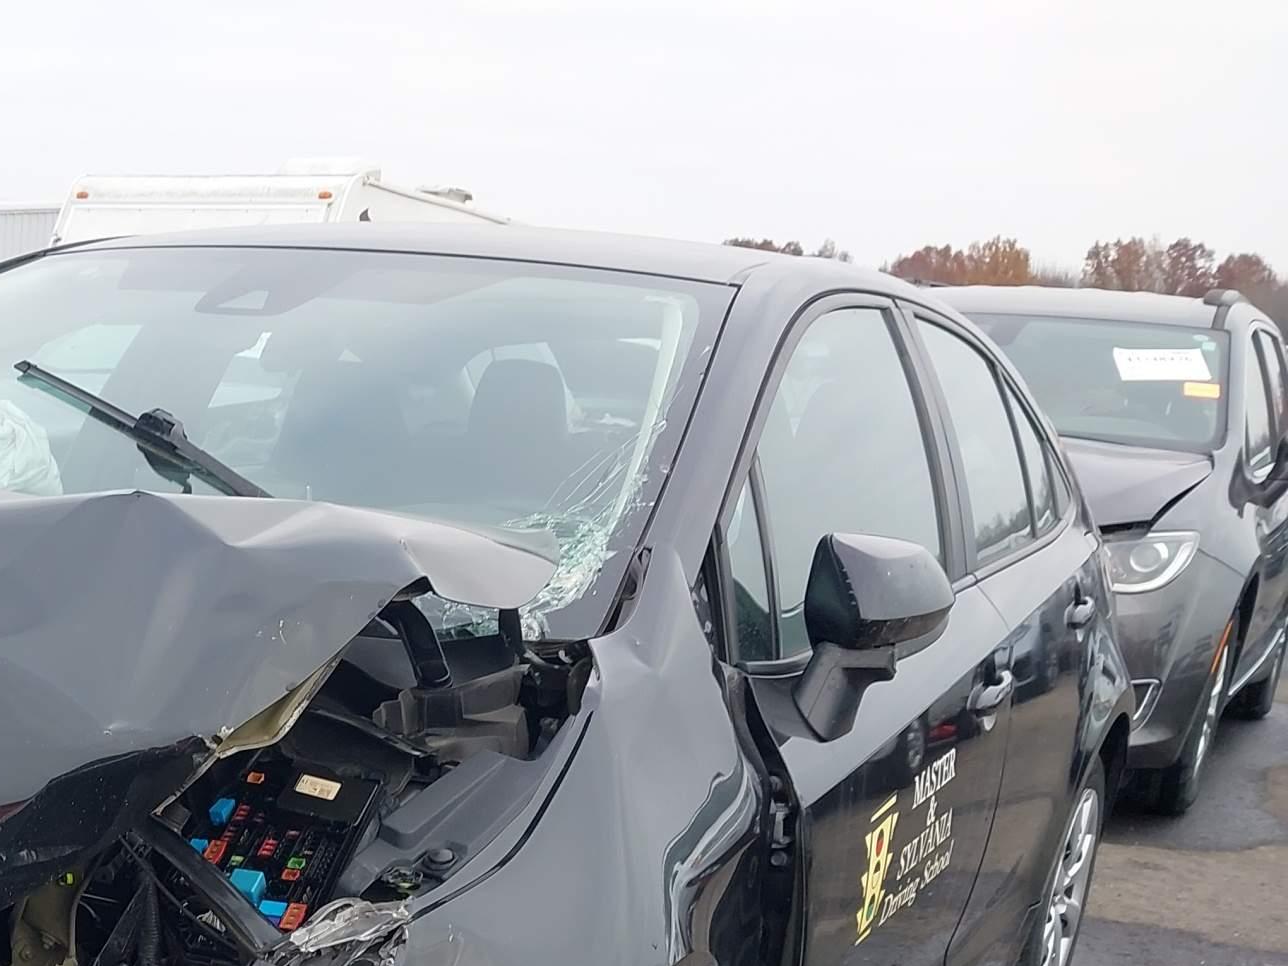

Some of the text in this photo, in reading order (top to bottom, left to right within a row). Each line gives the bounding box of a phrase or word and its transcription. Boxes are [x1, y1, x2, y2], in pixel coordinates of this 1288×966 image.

[912, 747, 957, 810] MASTER
[926, 795, 938, 827] &
[896, 807, 953, 881] SYLVANIA
[878, 839, 955, 927] Driving School
